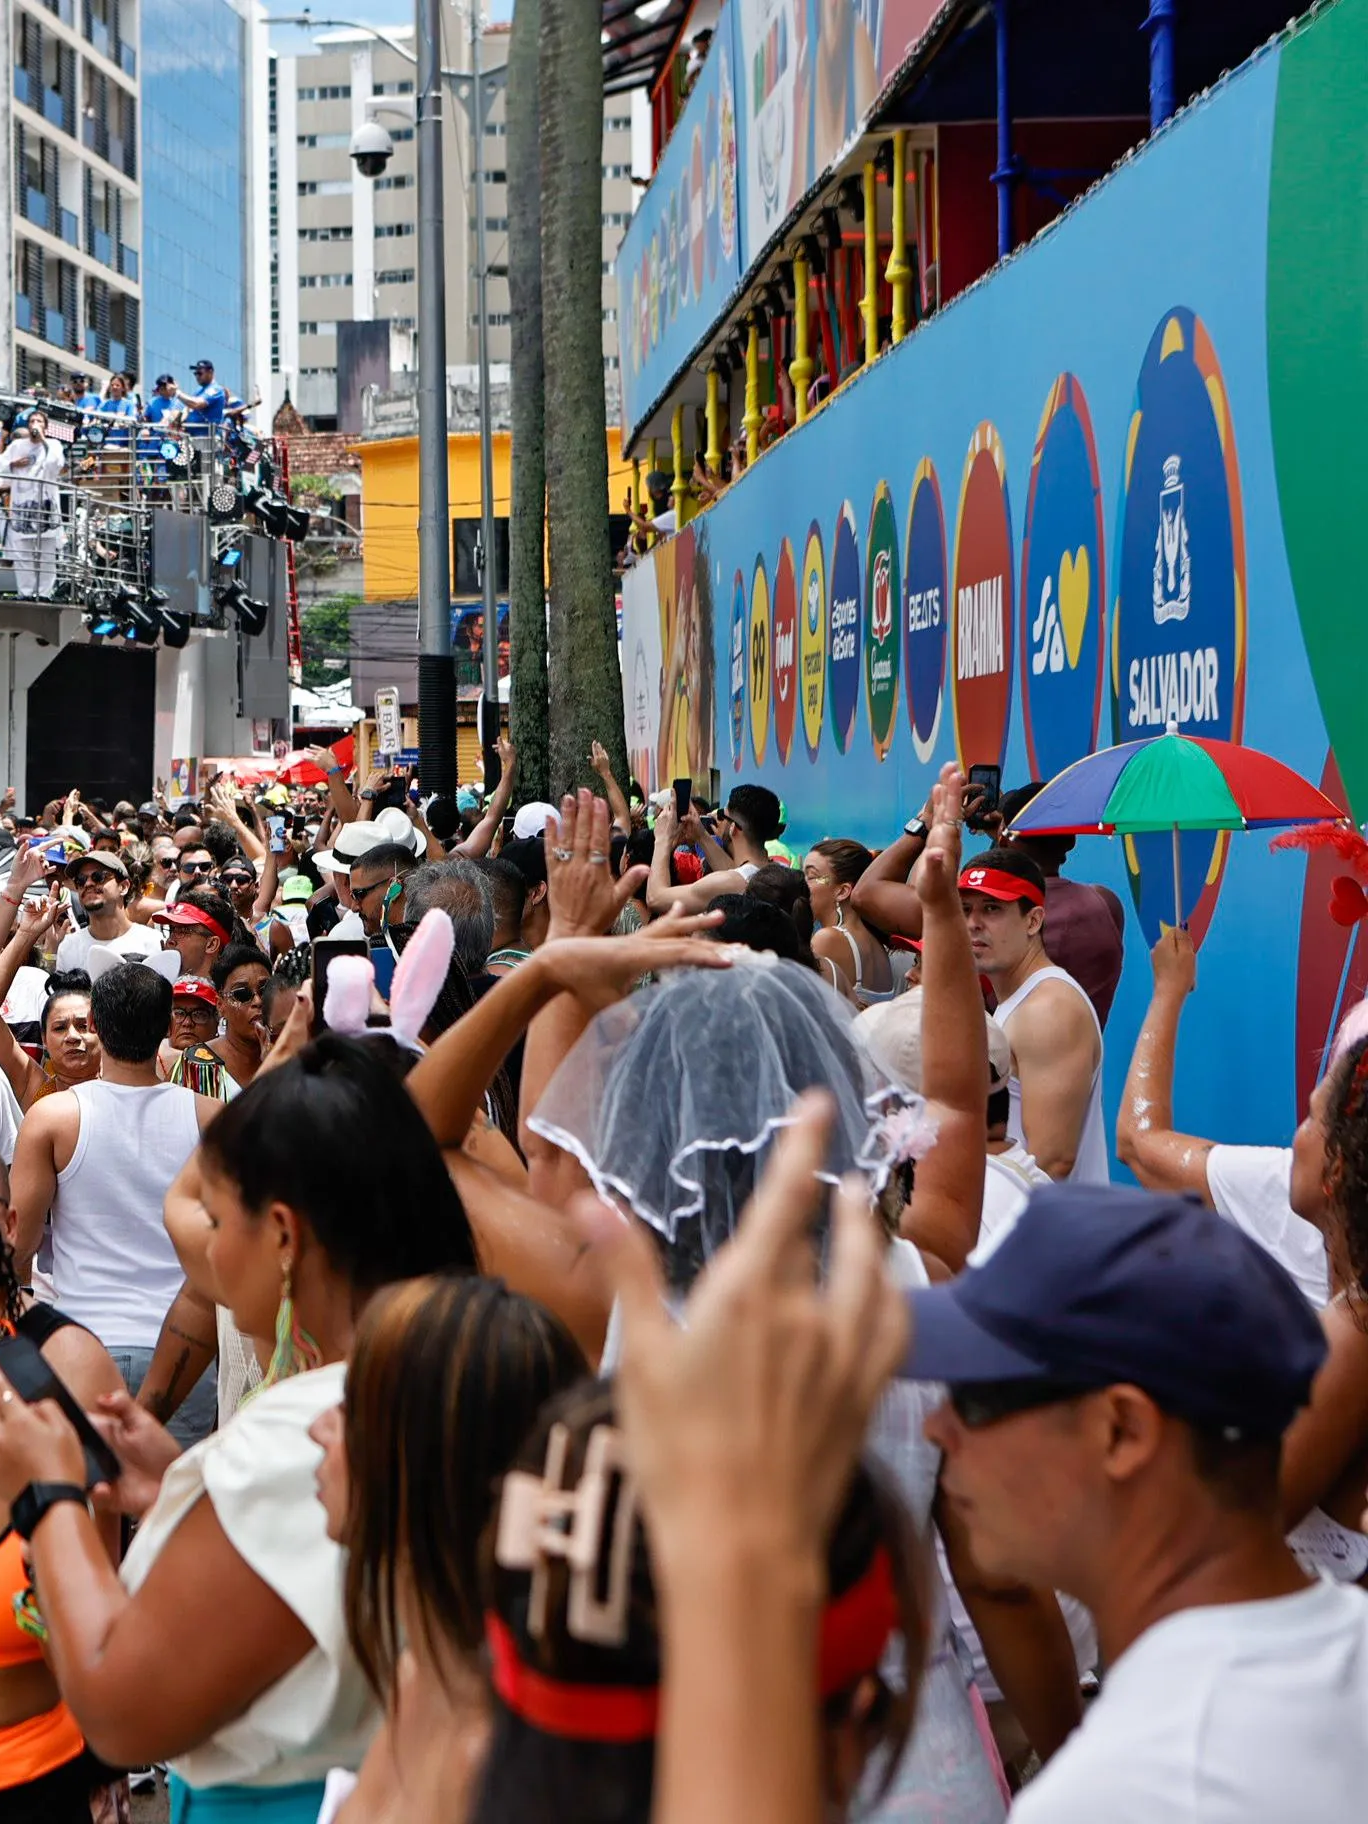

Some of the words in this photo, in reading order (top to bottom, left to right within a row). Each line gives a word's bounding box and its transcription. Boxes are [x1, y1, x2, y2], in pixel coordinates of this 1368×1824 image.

[908, 587, 940, 632] BEATS
[957, 575, 1004, 681] BRAHMA
[752, 620, 765, 703] 99
[1128, 647, 1220, 728] SALVADOR
[382, 712, 396, 749] BAR
